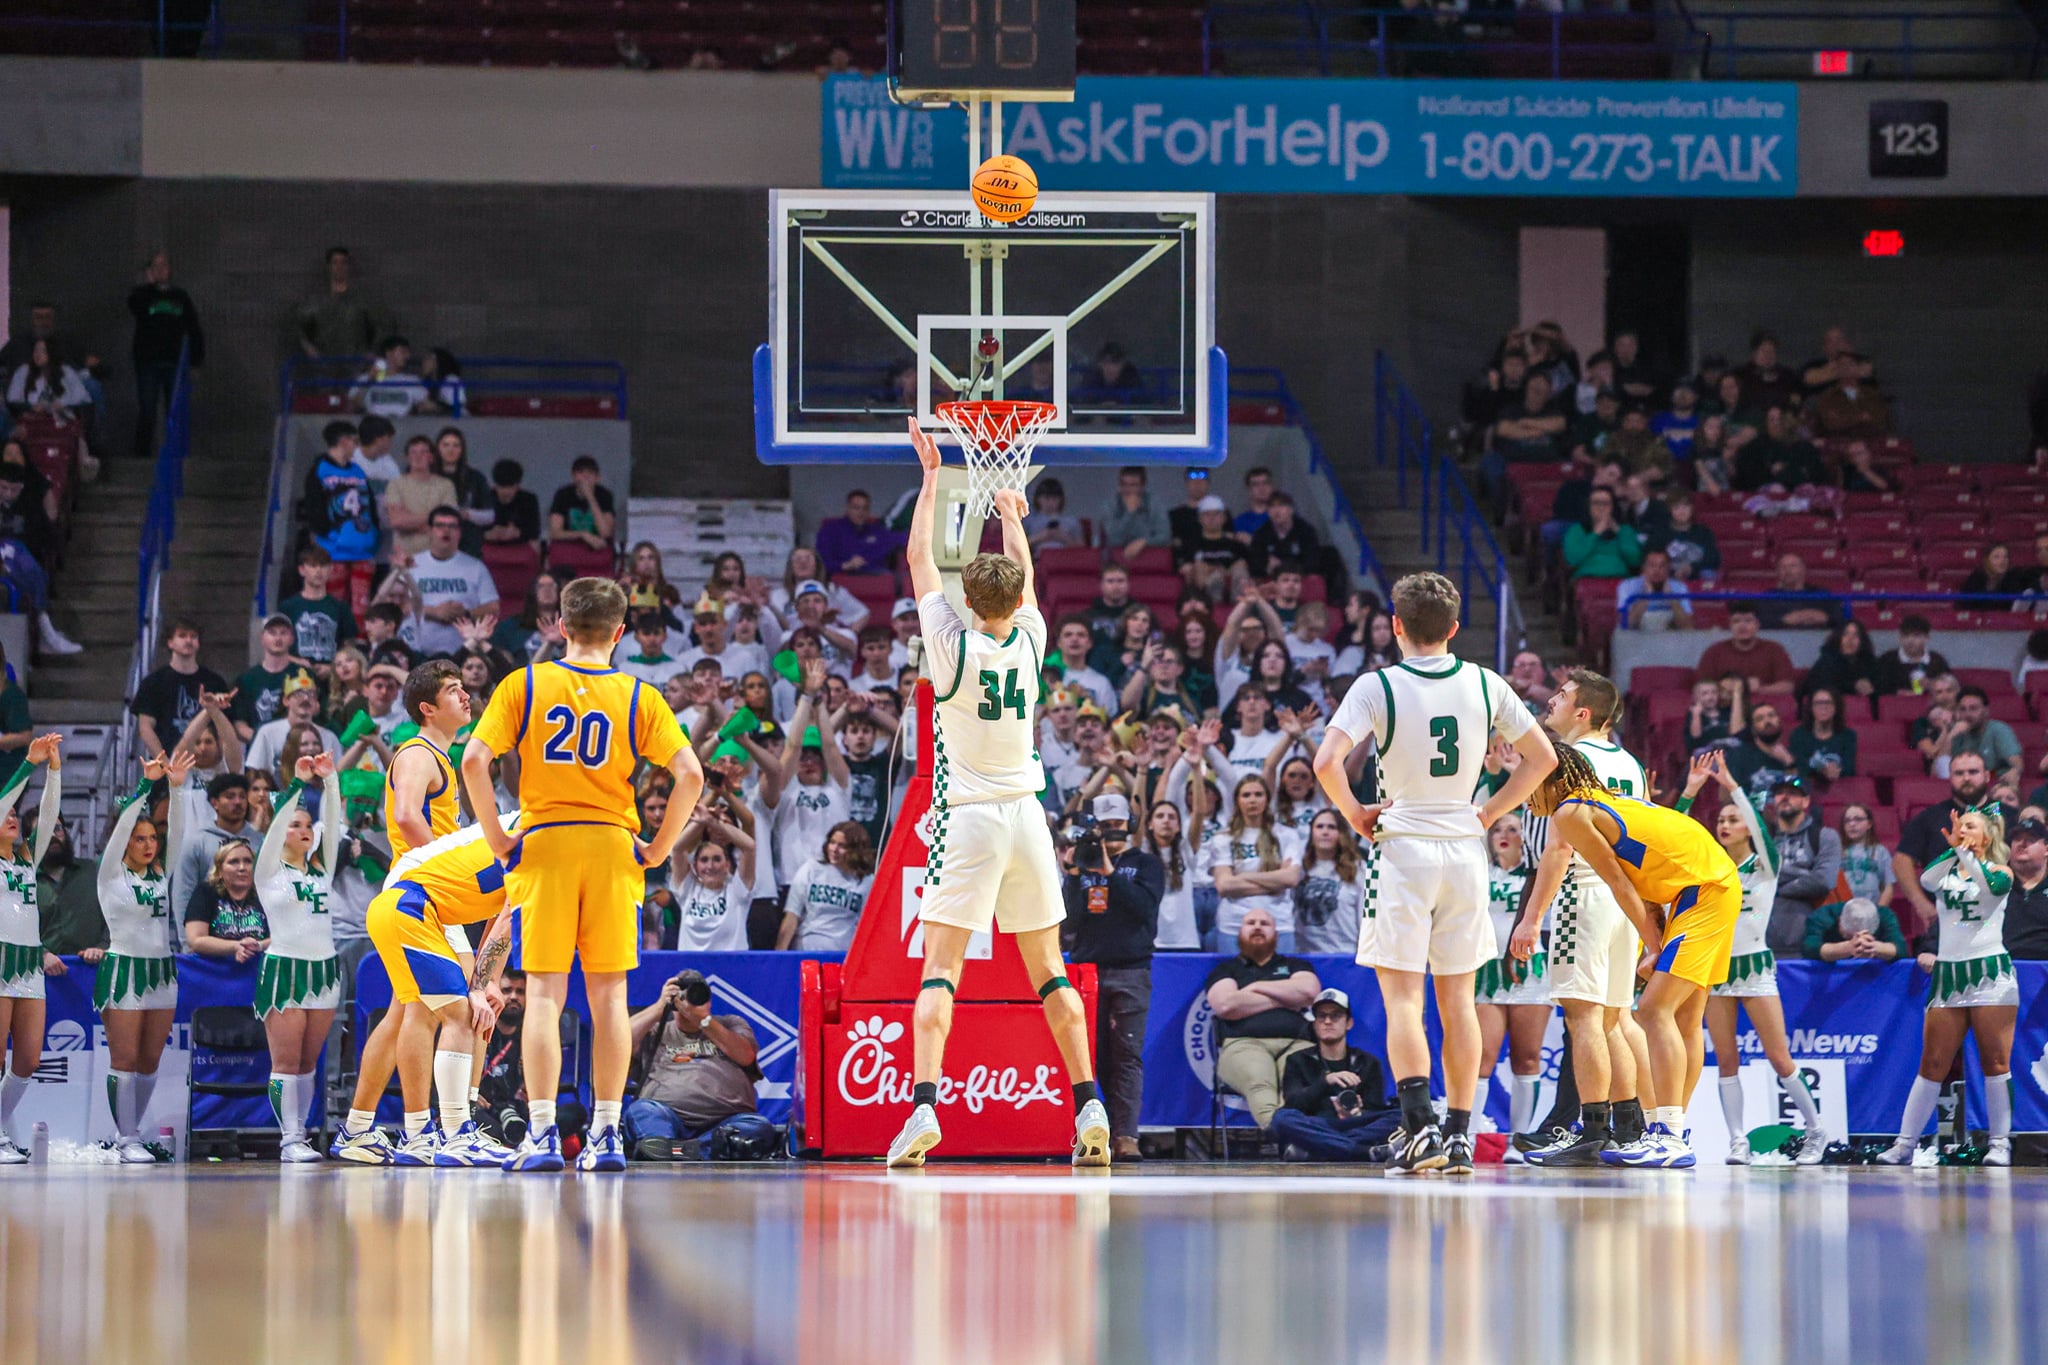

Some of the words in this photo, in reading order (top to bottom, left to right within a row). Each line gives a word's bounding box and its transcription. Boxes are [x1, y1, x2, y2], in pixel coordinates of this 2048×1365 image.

[833, 80, 893, 105] PREVE
[1418, 95, 1509, 116] National
[1515, 96, 1590, 117] Suicide
[1597, 96, 1706, 118] Prevention
[1713, 97, 1785, 119] Lifeline
[835, 109, 909, 169] WV
[1880, 123, 1940, 155] 123
[1419, 131, 1783, 182] 1-800-273-TALK
[991, 177, 1018, 191] EVO
[980, 194, 1022, 213] Wilson
[1015, 211, 1086, 227] Coliseum
[342, 488, 362, 518] 4
[978, 667, 1026, 721] 34
[543, 703, 614, 771] 20
[1429, 715, 1459, 778] 3
[809, 883, 863, 912] RESERVED
[209, 1054, 255, 1067] Company
[838, 1037, 1064, 1114] Chik-fil-A
